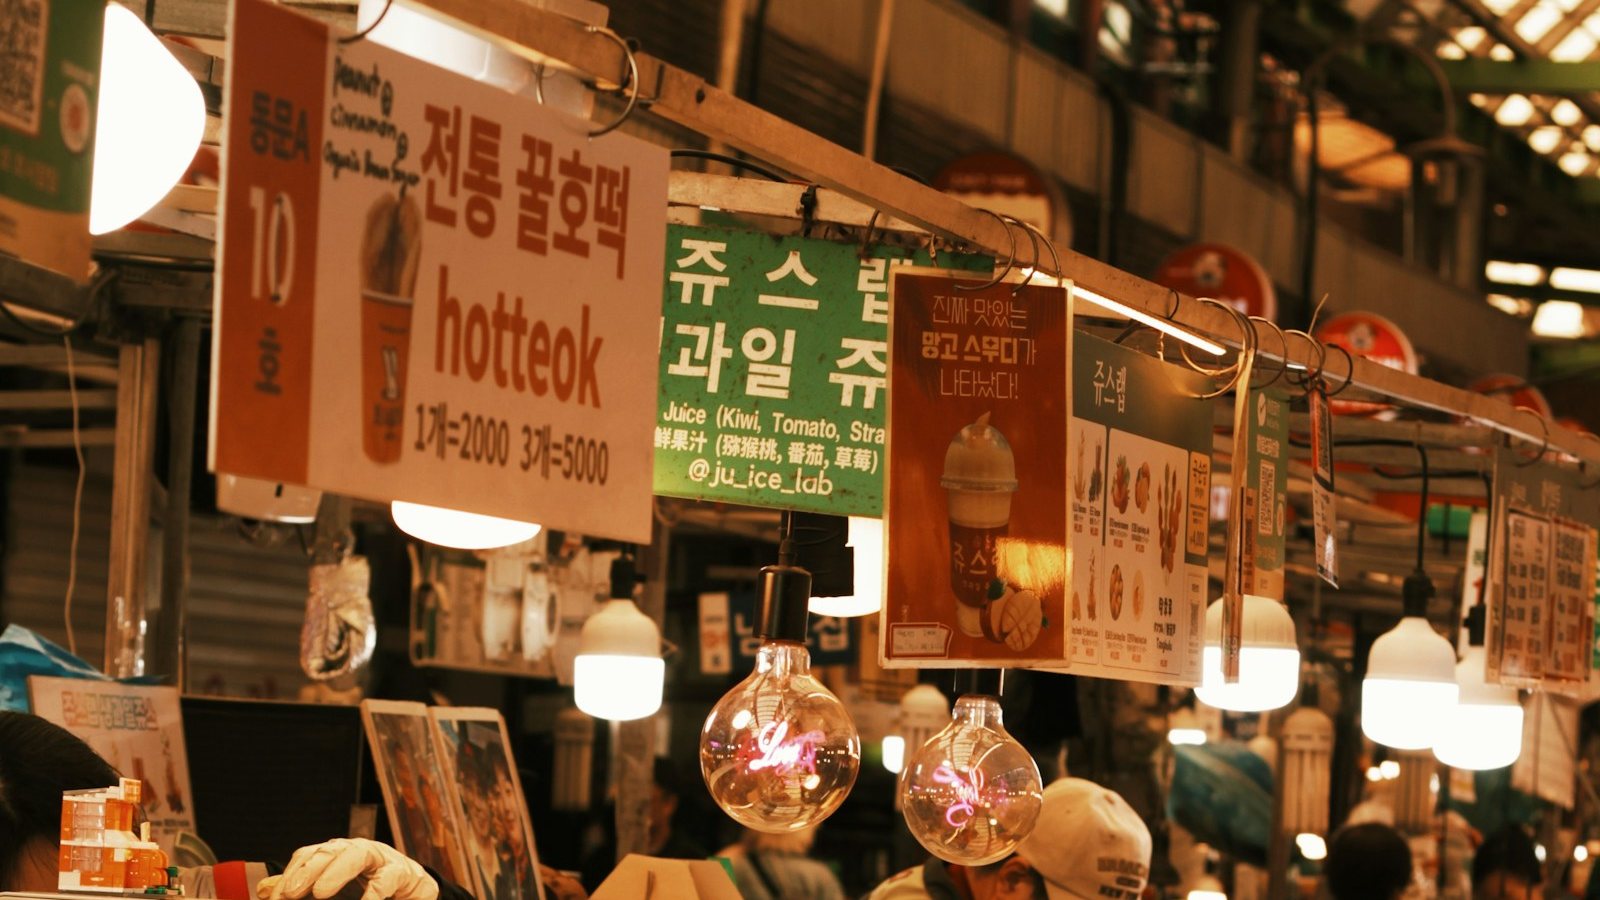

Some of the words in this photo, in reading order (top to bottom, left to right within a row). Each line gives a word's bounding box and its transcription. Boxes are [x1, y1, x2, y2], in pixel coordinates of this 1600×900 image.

[420, 103, 502, 239] 전통
[516, 133, 631, 280] 꿀호떡
[249, 186, 296, 307] 10
[933, 295, 968, 325] 진짜
[974, 299, 1027, 329] 맛있는
[435, 264, 603, 409] hotteok
[658, 316, 795, 399] 과일
[922, 331, 958, 361] 망고
[963, 334, 1037, 365] 스무디가
[940, 368, 1019, 399] 나타났다!
[1092, 360, 1127, 413] 쥬스랩
[414, 402, 510, 467] 1개=2000
[520, 424, 609, 486] 3개=5000
[663, 401, 707, 424] Juice
[716, 404, 762, 434] (Kiwi,
[772, 412, 840, 443] Tomato,
[850, 420, 886, 444] Stra
[688, 458, 833, 496] @ju_ice_lab
[834, 446, 878, 475] 草莓)
